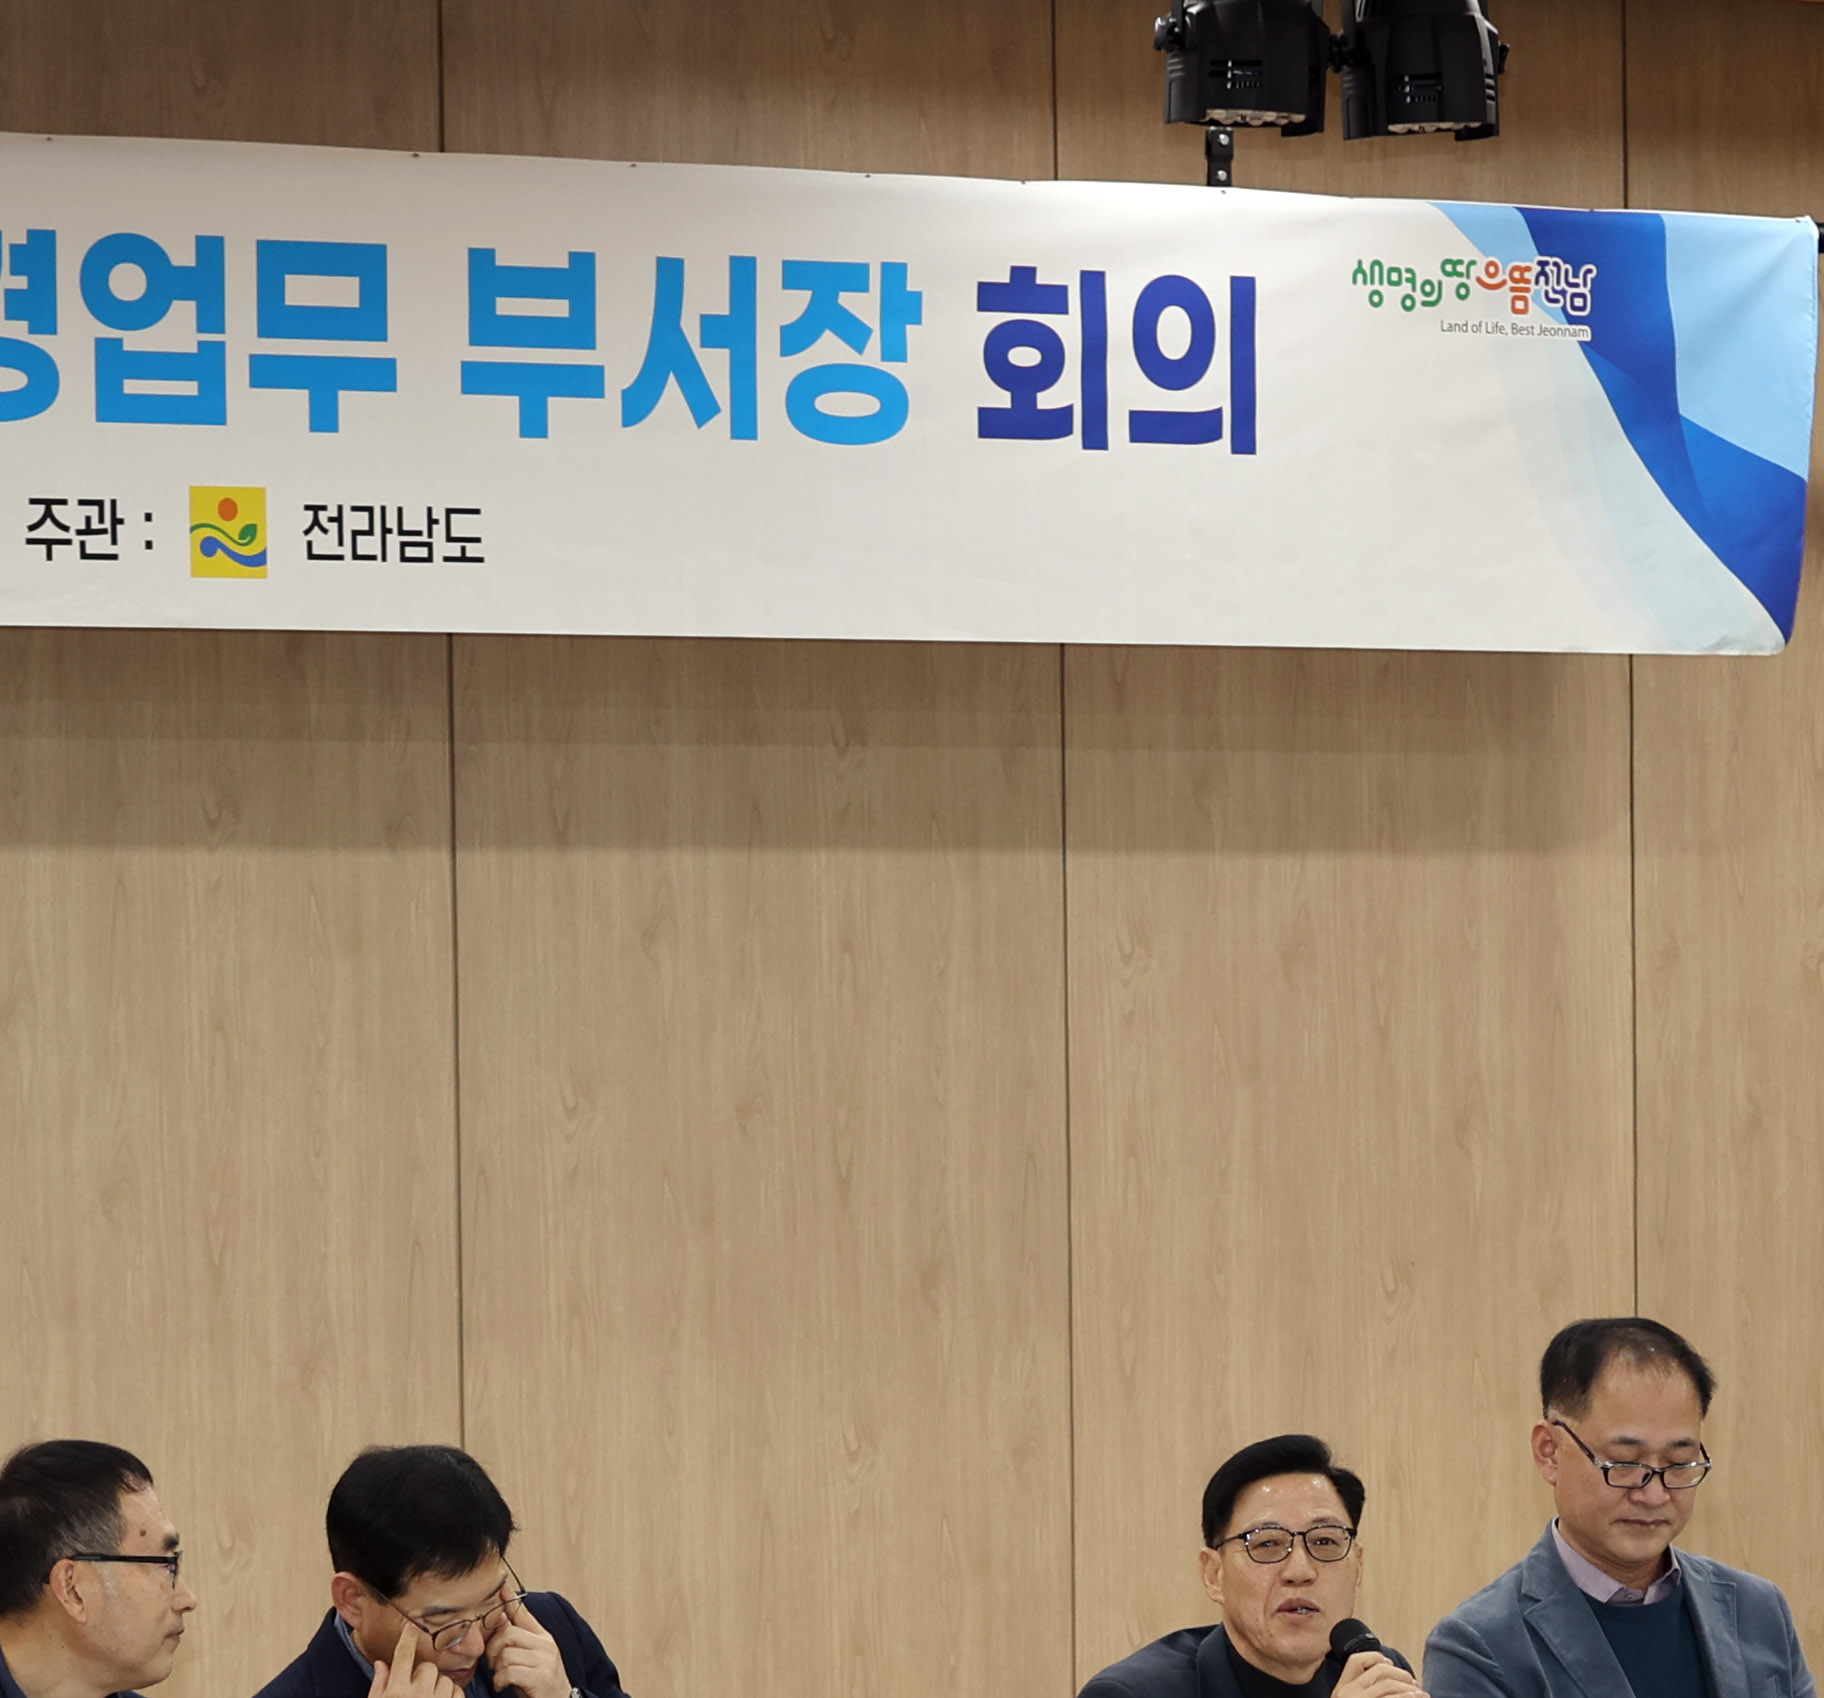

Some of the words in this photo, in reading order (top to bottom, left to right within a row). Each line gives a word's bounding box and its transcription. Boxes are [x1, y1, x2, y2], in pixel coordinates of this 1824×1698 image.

[462, 248, 924, 447] 부서장
[979, 267, 1257, 456] 회의
[1440, 319, 1468, 333] Land
[1471, 321, 1482, 333] of
[1485, 321, 1509, 337] Life,
[1511, 322, 1534, 336] Best
[1537, 324, 1589, 338] Jeonnam
[25, 497, 125, 562] 주관
[303, 504, 485, 566] 전라남도
